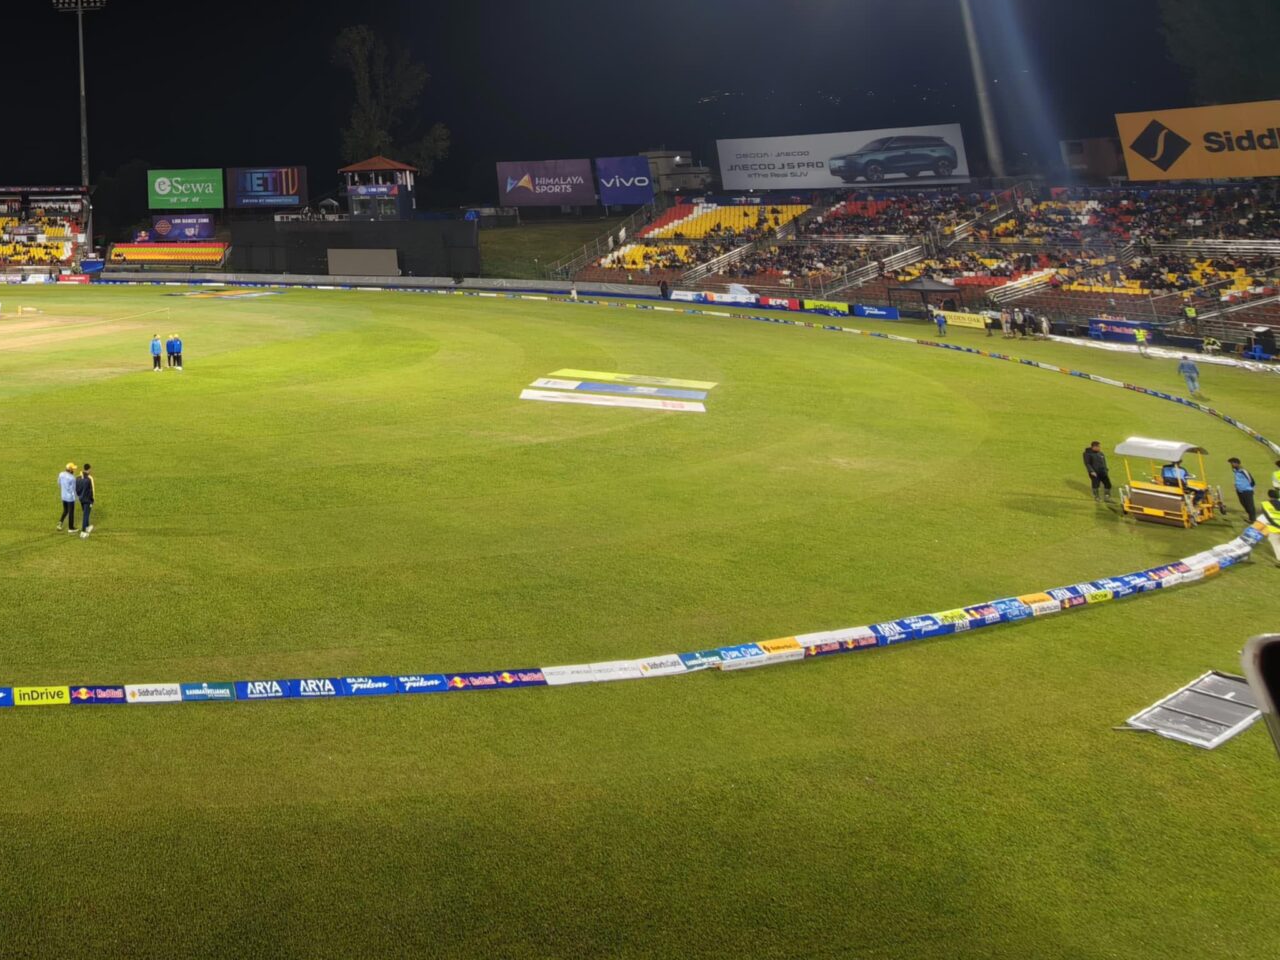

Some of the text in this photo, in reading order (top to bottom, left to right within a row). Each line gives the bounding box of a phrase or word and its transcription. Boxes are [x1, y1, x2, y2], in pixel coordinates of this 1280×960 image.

[727, 163, 776, 172] JAECOO
[797, 161, 824, 169] PRO
[535, 176, 584, 184] HIMALAYA
[601, 175, 650, 188] vivo
[155, 177, 214, 195] eSewa
[535, 185, 572, 193] SPORTS
[769, 298, 789, 307] KFC
[248, 681, 282, 694] ARYA
[300, 679, 335, 692] ARYA
[19, 689, 64, 701] inDrive
[138, 687, 178, 697] Siddhartha Capital
